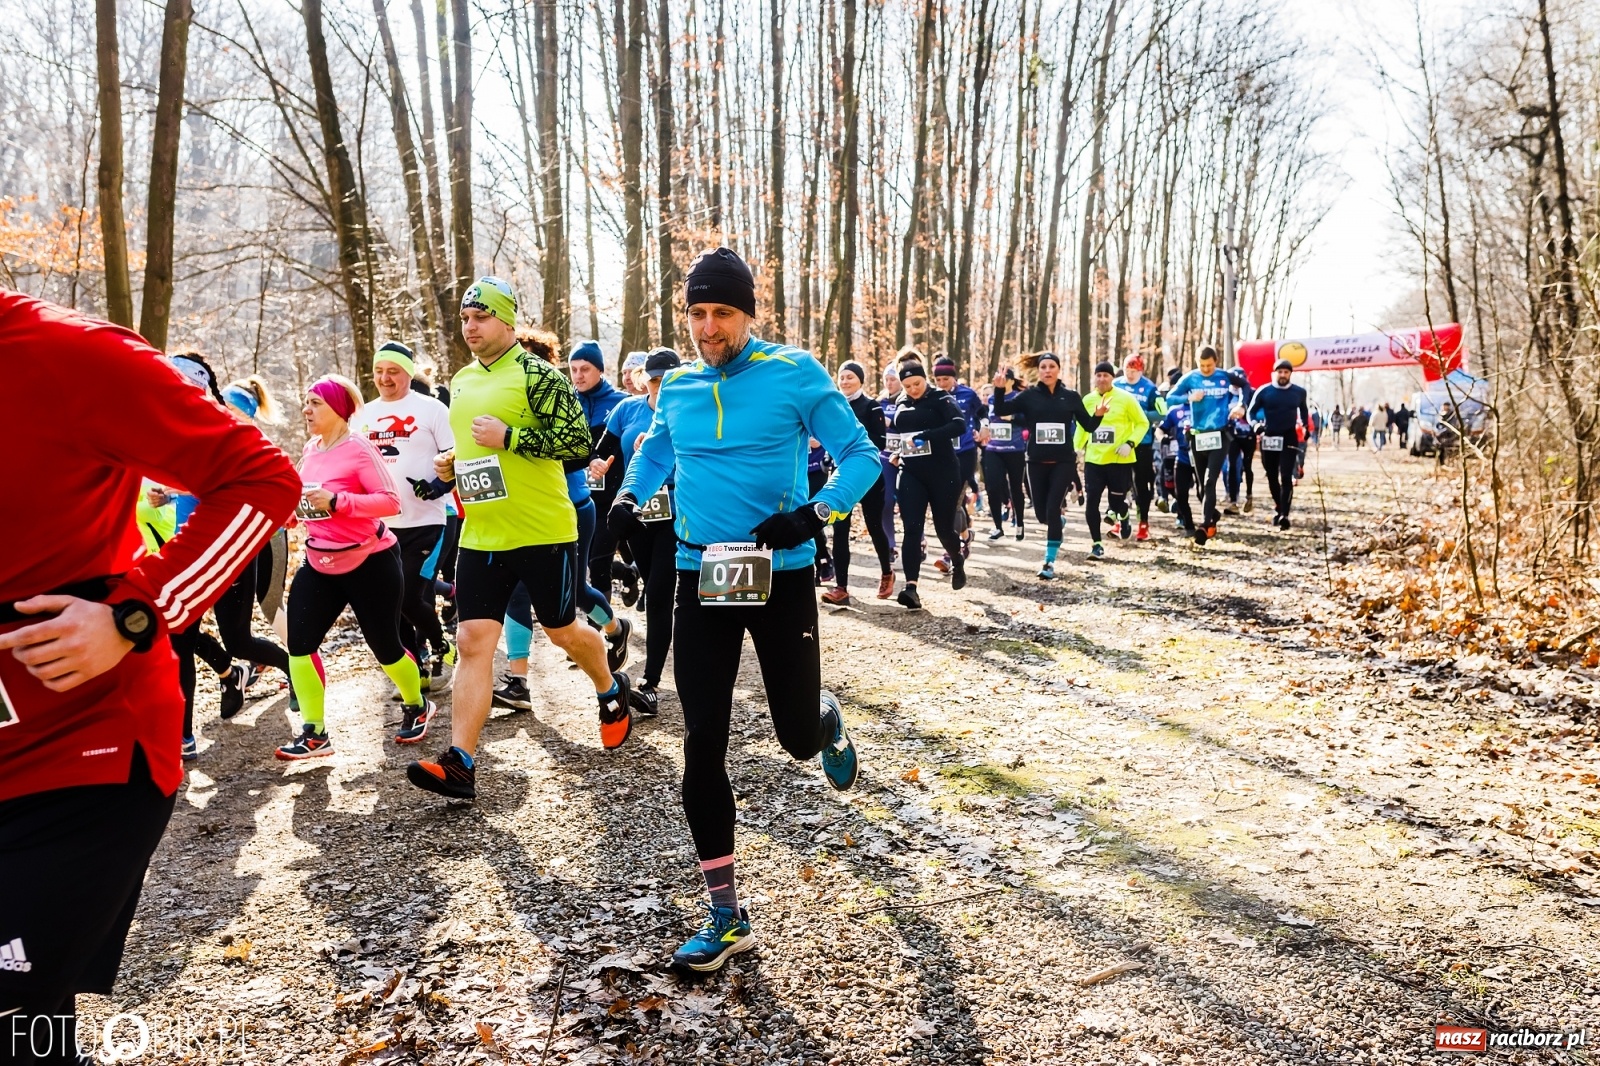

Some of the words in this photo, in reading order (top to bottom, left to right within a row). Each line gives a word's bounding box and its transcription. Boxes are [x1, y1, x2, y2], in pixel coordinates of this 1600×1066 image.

[1314, 345, 1380, 356] TWARDZIELA
[1043, 429, 1058, 439] 112
[1095, 431, 1110, 440] 127
[461, 472, 492, 491] 066
[713, 563, 754, 586] 071
